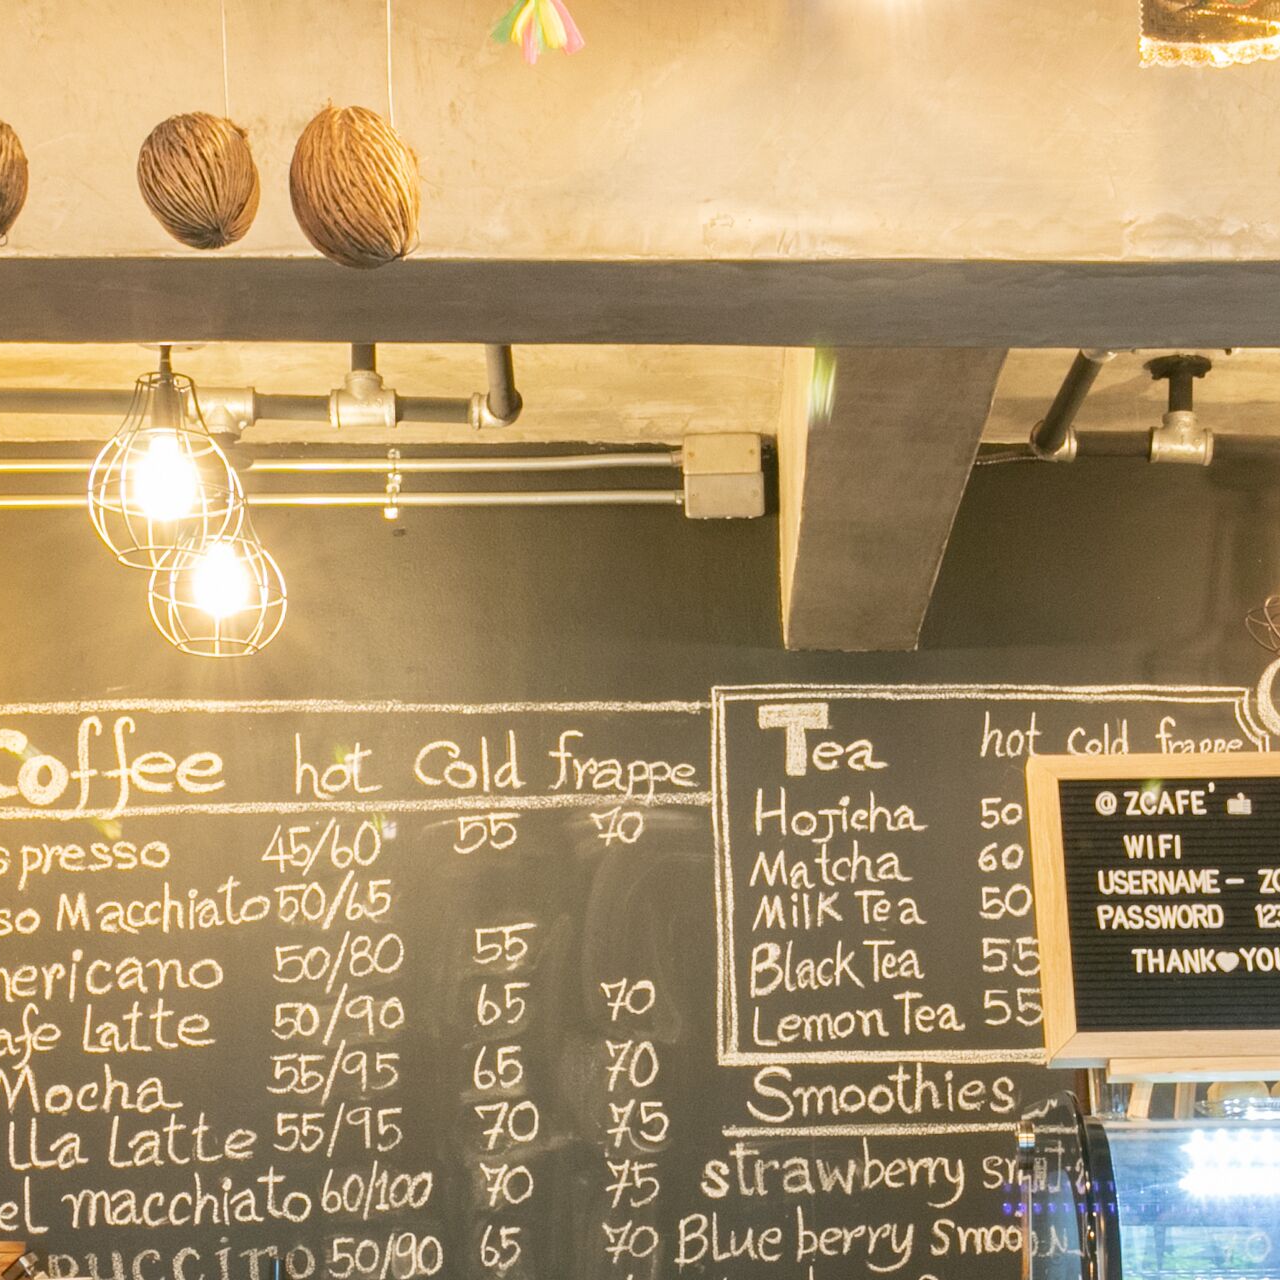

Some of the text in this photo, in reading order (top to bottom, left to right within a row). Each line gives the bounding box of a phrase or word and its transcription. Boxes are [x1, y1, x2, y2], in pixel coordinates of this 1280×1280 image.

[758, 702, 887, 777] Tea
[980, 711, 1042, 759] hot
[296, 733, 382, 801] hot
[415, 729, 525, 793] Cold
[549, 730, 698, 803] frappe
[262, 817, 382, 876] 45/60
[453, 813, 521, 854] 55
[589, 809, 645, 846] 70
[755, 787, 1023, 844] Hojicha 50
[749, 841, 1024, 888] Matcha 60
[1123, 834, 1183, 859] WIFI
[57, 874, 271, 935] Macchiato
[276, 869, 392, 931] 50/65
[853, 891, 928, 926] Tea
[980, 884, 1032, 918] 50
[1097, 868, 1221, 895] USERNAME
[1096, 903, 1223, 931] PASSWORD
[273, 931, 404, 993] 50/80
[473, 922, 537, 963] 55
[749, 936, 1041, 997] Black Tea 55
[83, 999, 216, 1053] Latte
[272, 983, 405, 1045] 50/90
[477, 982, 530, 1026] 65
[600, 978, 656, 1021] 70
[752, 988, 1042, 1046] Lemon Tea 55
[266, 1040, 400, 1104] 55/95
[472, 1046, 524, 1090] 65
[604, 1040, 658, 1090] 70
[747, 1065, 1015, 1121] Smoothies
[108, 1111, 257, 1169] Latte
[273, 1103, 404, 1158] 55/95
[474, 1101, 540, 1146] 70
[607, 1100, 670, 1148] 75
[61, 1166, 313, 1229] macchiato
[320, 1160, 434, 1222] 60/100
[480, 1163, 533, 1206] 70
[606, 1160, 660, 1206] 75
[700, 1137, 966, 1208] strawberry
[328, 1234, 442, 1280] 50/90
[480, 1225, 522, 1267] 65
[603, 1221, 658, 1259] 70
